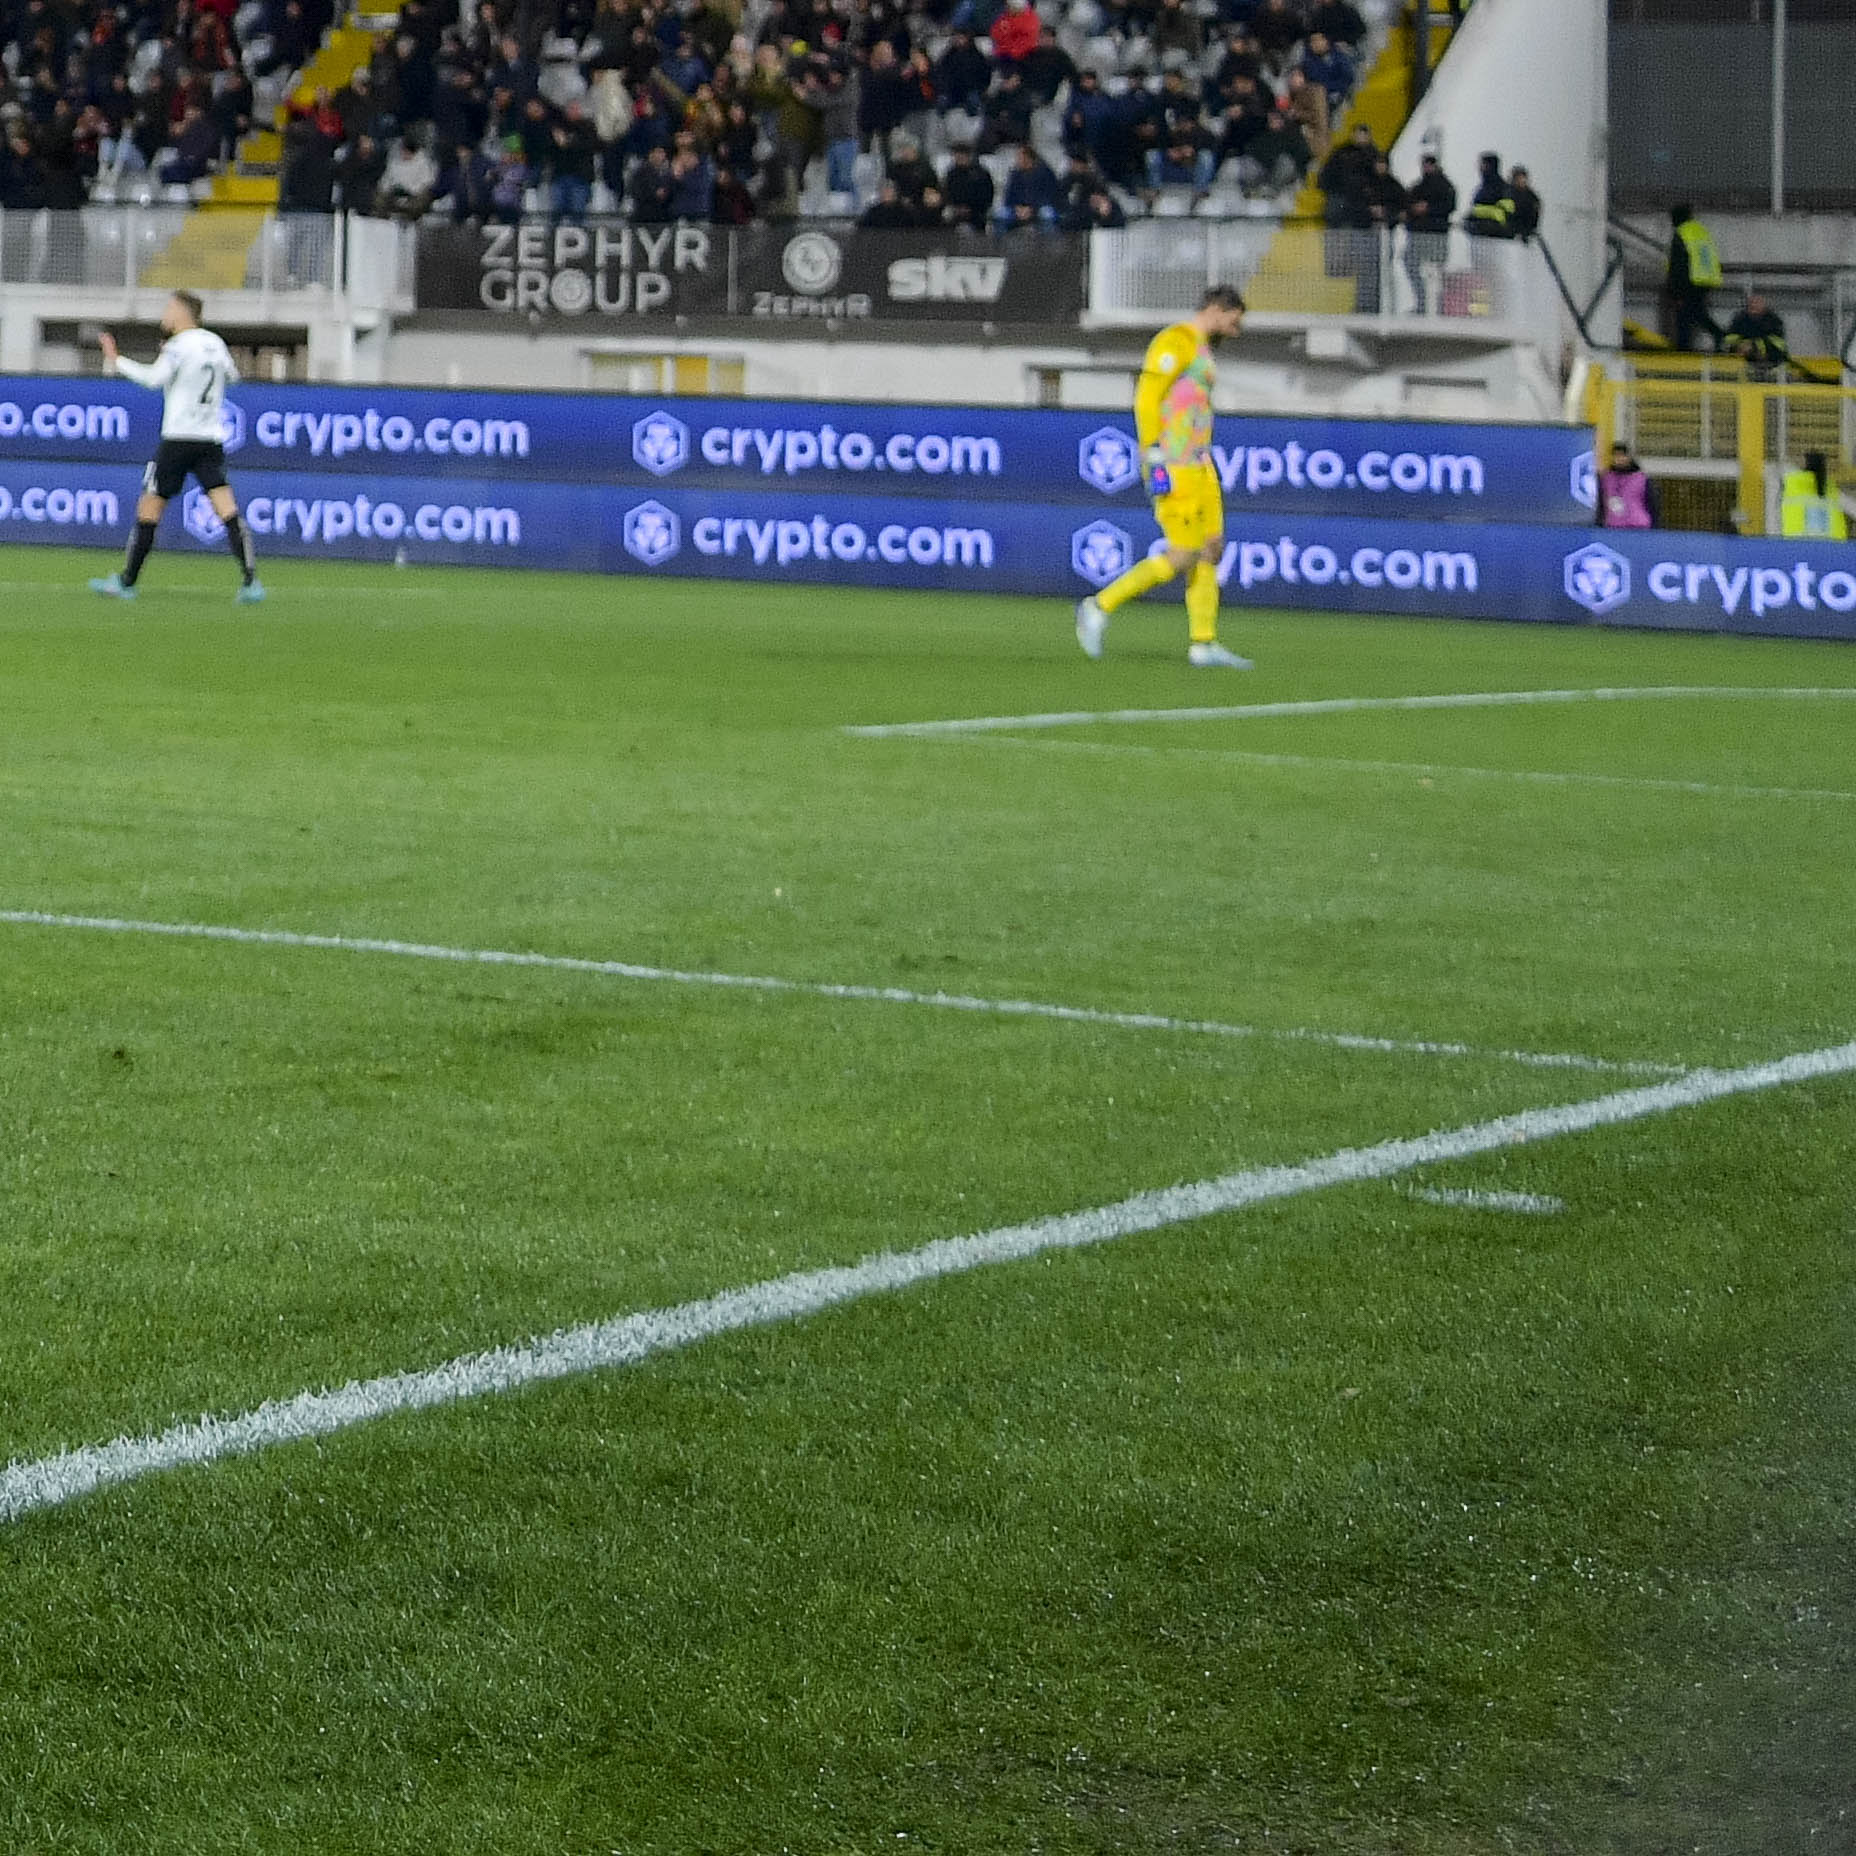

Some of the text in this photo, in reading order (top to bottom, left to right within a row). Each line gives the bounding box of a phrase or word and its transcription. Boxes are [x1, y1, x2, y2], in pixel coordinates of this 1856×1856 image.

[482, 224, 709, 273] ZEPHYR
[479, 269, 671, 315] GROUP
[199, 364, 215, 404] 2
[256, 408, 530, 457] crypto.com
[701, 424, 1001, 476] crypto.com
[1212, 441, 1484, 494] ypto.com
[246, 494, 521, 544] crypto.com
[692, 514, 993, 568] crypto.com
[1648, 562, 1856, 617] crypto
